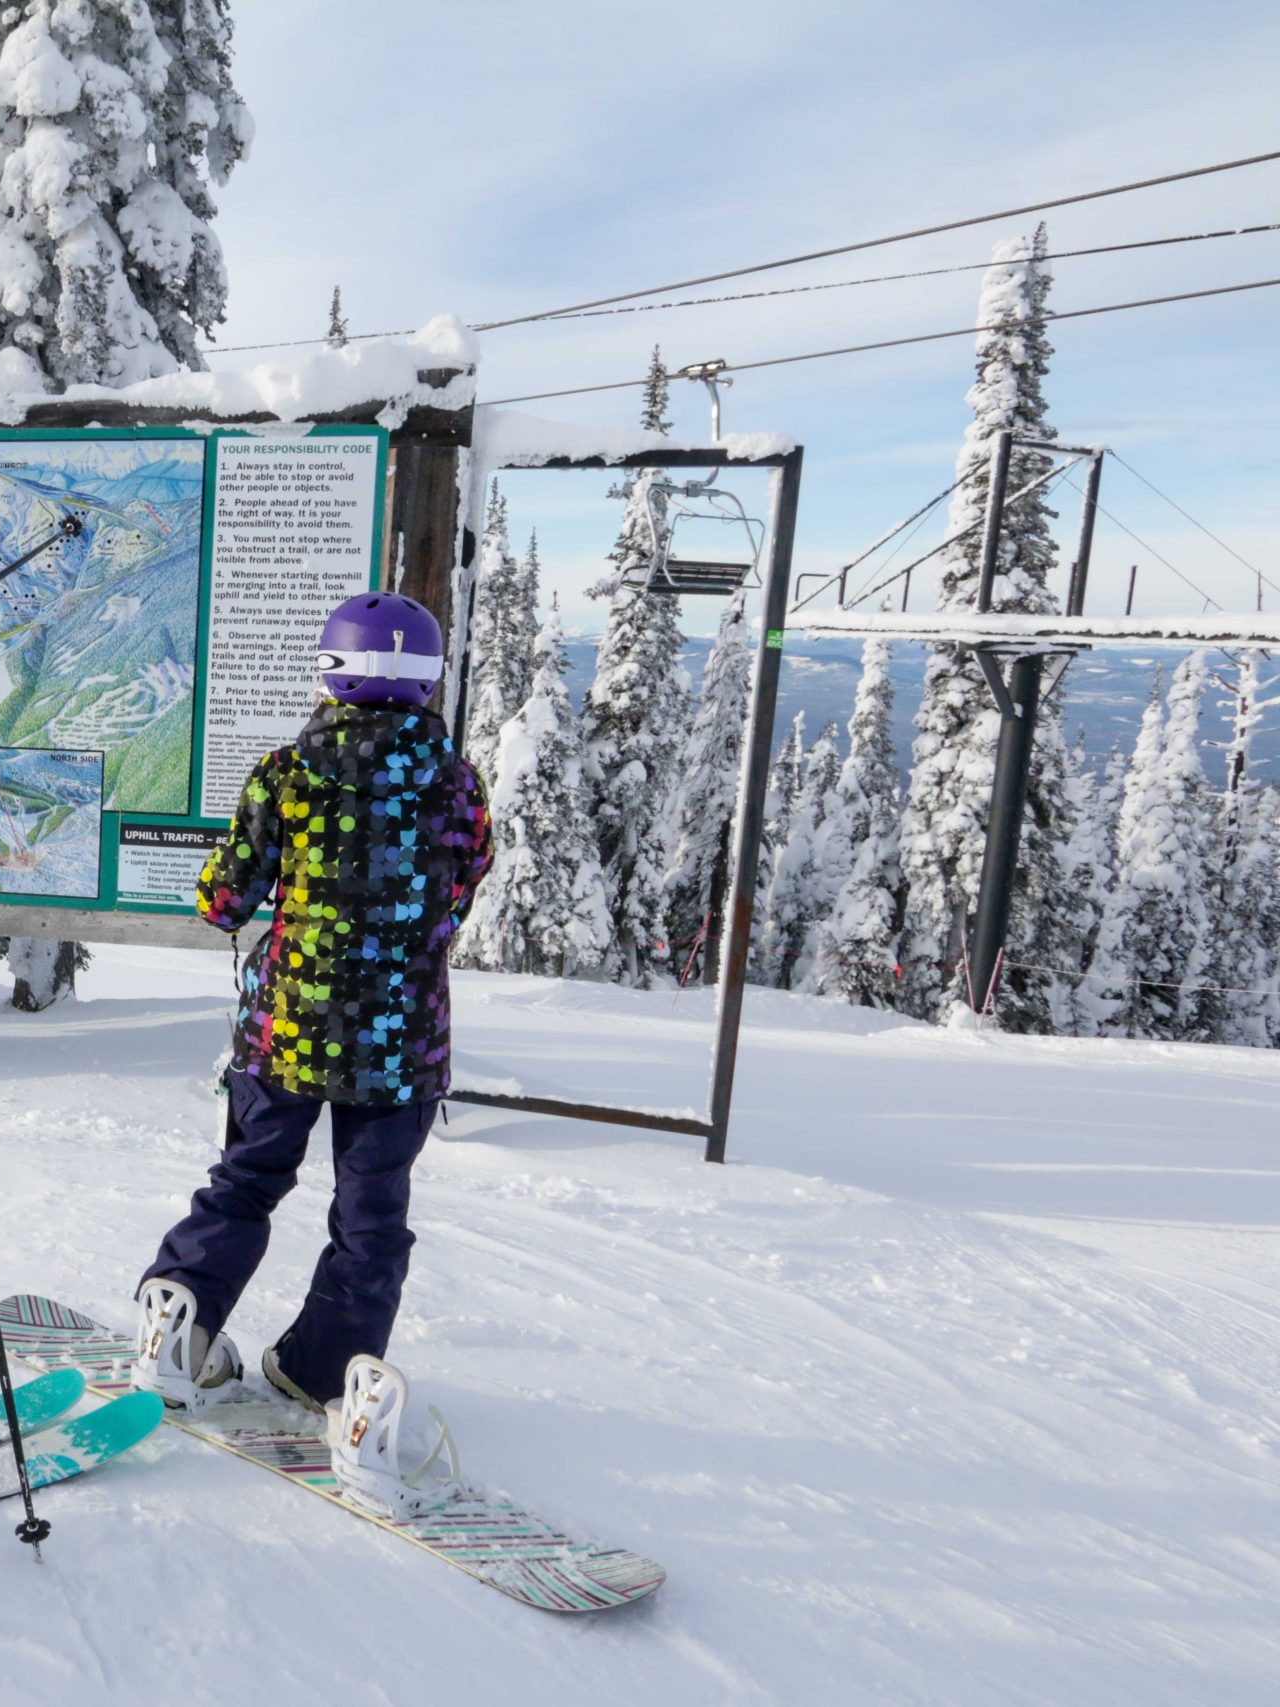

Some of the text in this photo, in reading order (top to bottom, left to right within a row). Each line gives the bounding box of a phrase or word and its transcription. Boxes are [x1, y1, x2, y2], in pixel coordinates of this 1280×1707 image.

[222, 444, 371, 453] YOUR RESPONSIBILITY CODE
[236, 462, 269, 471] Always
[273, 462, 293, 471] stay
[308, 462, 345, 470] control,
[291, 473, 312, 482] stop
[247, 483, 278, 492] people
[294, 483, 332, 492] objects.
[234, 498, 266, 507] People
[237, 509, 258, 518] right
[218, 519, 280, 528] responsibility
[298, 536, 319, 544] stop
[216, 546, 232, 555] you
[280, 571, 318, 580] starting
[227, 581, 265, 591] merging
[214, 591, 239, 599] uphill
[263, 592, 285, 600] yield
[230, 606, 262, 615] Always
[252, 618, 290, 626] runaway
[232, 642, 276, 651] warnings.
[280, 643, 304, 652] Keep
[212, 652, 235, 660] trails
[287, 665, 306, 674] may
[226, 686, 247, 695] Prior
[263, 688, 288, 698] using
[209, 707, 237, 718] ability
[253, 708, 275, 716] load,
[208, 717, 237, 726] safely.
[125, 830, 159, 840] UPHILL
[162, 832, 203, 842] TRAFFIC
